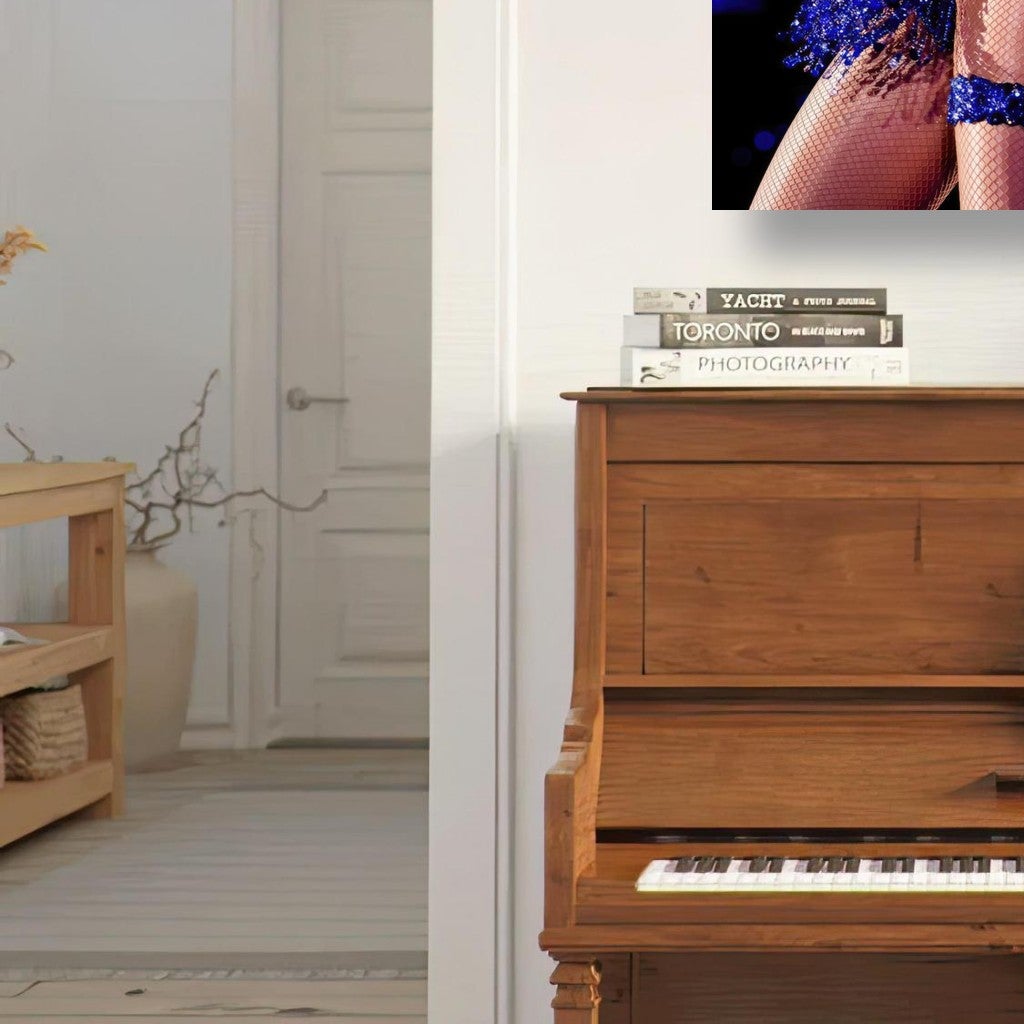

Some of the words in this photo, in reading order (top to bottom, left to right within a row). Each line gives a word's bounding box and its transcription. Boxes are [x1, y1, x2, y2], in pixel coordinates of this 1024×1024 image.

[721, 293, 786, 309] YACHT
[672, 321, 780, 342] TORONTO
[698, 356, 852, 371] PHOTOGRAPHY
